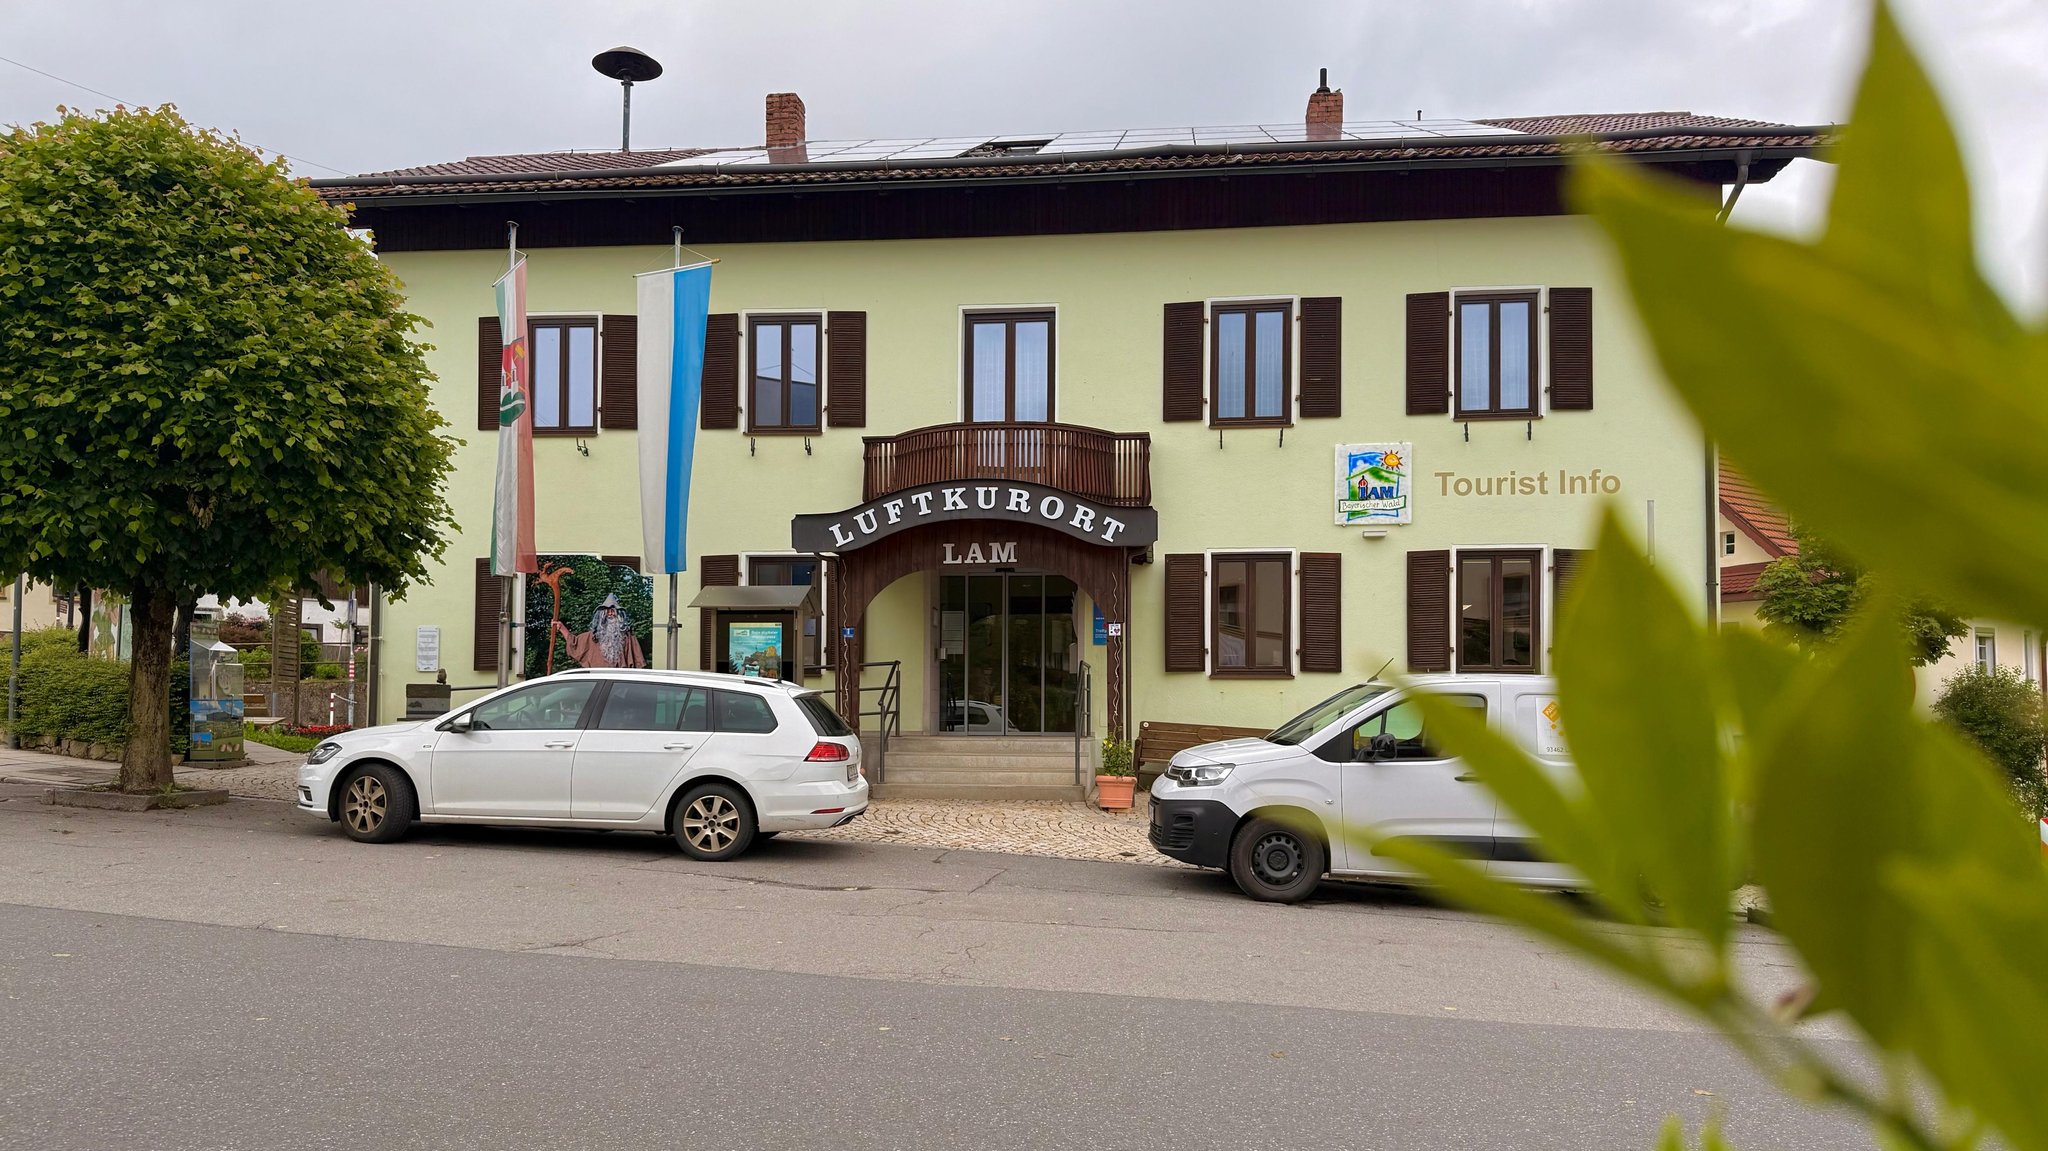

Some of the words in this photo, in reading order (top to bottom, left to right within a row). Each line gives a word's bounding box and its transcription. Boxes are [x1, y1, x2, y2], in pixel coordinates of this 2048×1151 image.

[1434, 470, 1548, 497] Tourist
[1559, 468, 1621, 495] Info
[1382, 499, 1400, 508] Wald
[829, 486, 1125, 548] LUFTKURORT
[943, 541, 1018, 564] LAM
